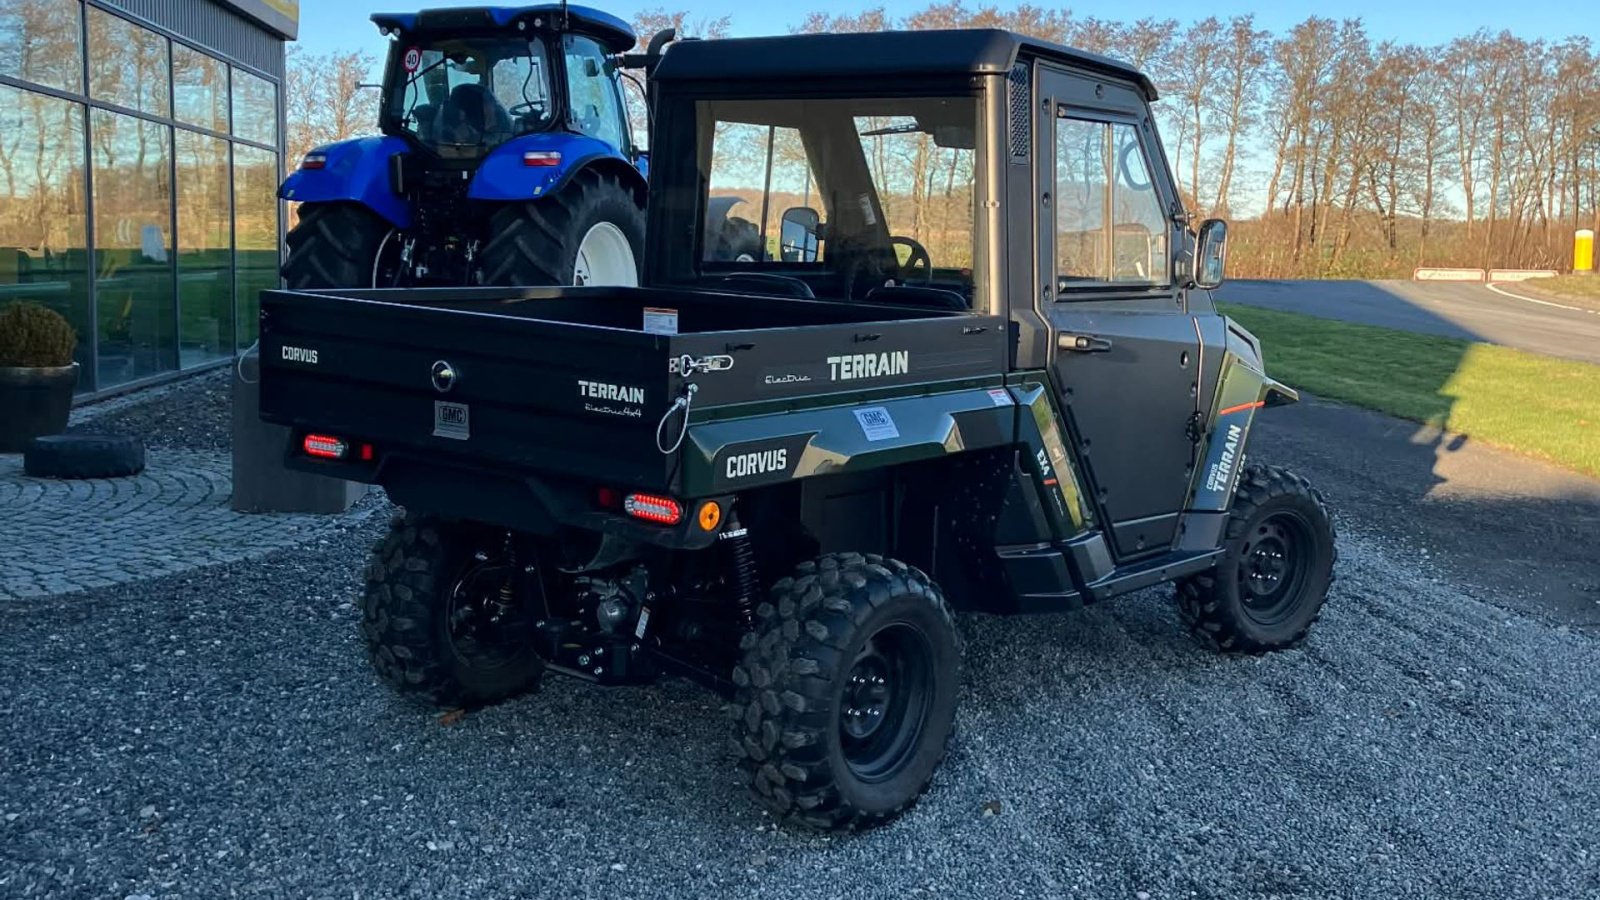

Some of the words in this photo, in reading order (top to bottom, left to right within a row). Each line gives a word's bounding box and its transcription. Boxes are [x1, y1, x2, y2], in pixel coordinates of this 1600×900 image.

[406, 54, 417, 66] 40
[282, 345, 318, 364] CORVUS
[827, 350, 909, 381] TERRAIN
[764, 374, 812, 385] Electric
[578, 380, 645, 404] TERRAIN
[441, 407, 464, 422] GMC
[863, 410, 886, 424] GMC
[726, 448, 787, 478] CORVUS
[1212, 424, 1242, 492] TERRAIN
[1206, 463, 1219, 490] CORVUS
